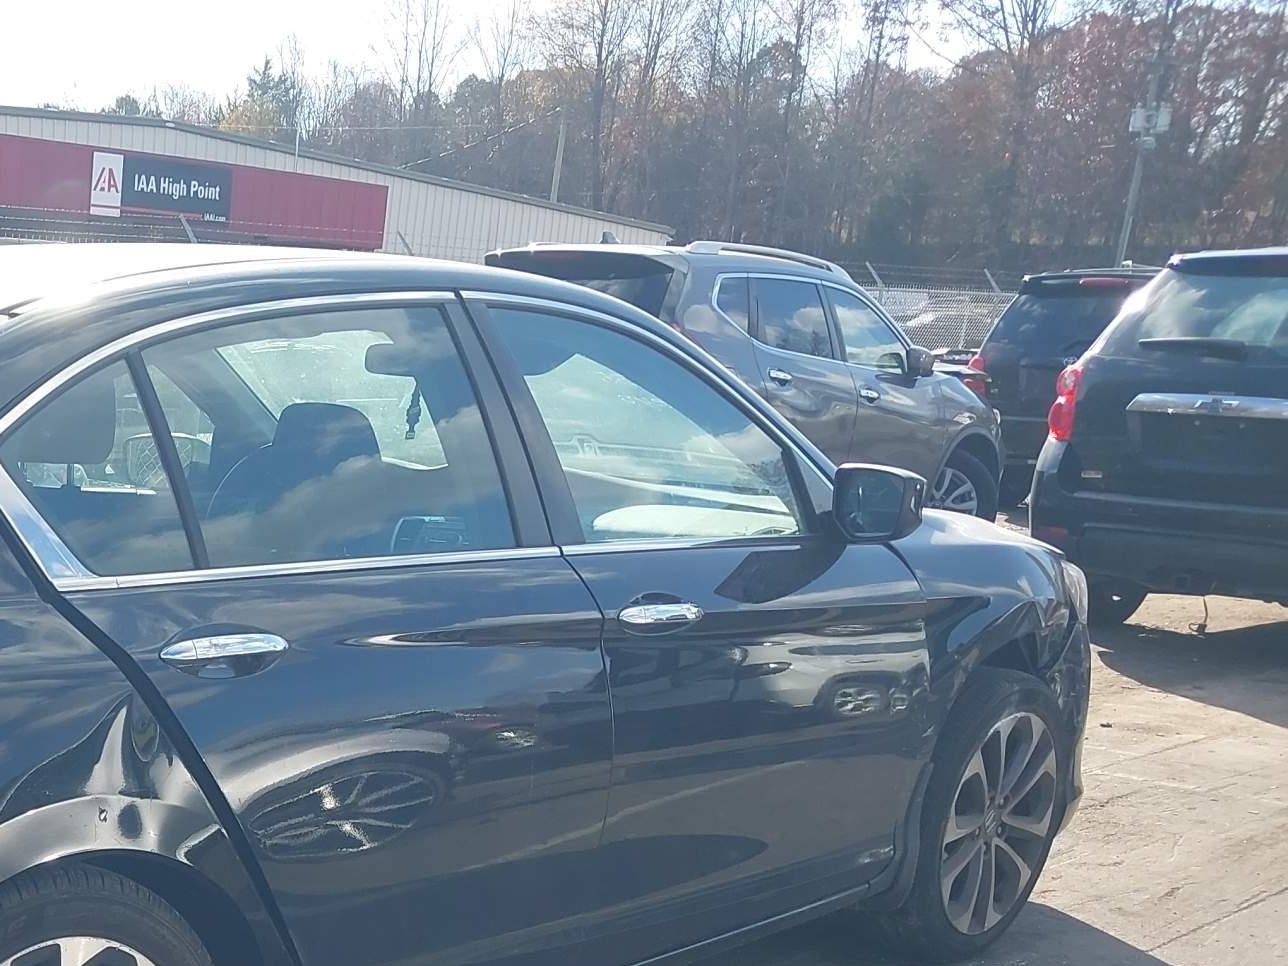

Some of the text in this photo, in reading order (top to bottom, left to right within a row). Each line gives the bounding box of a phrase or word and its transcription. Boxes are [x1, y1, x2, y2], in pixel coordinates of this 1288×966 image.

[134, 174, 220, 201] IAA High Point
